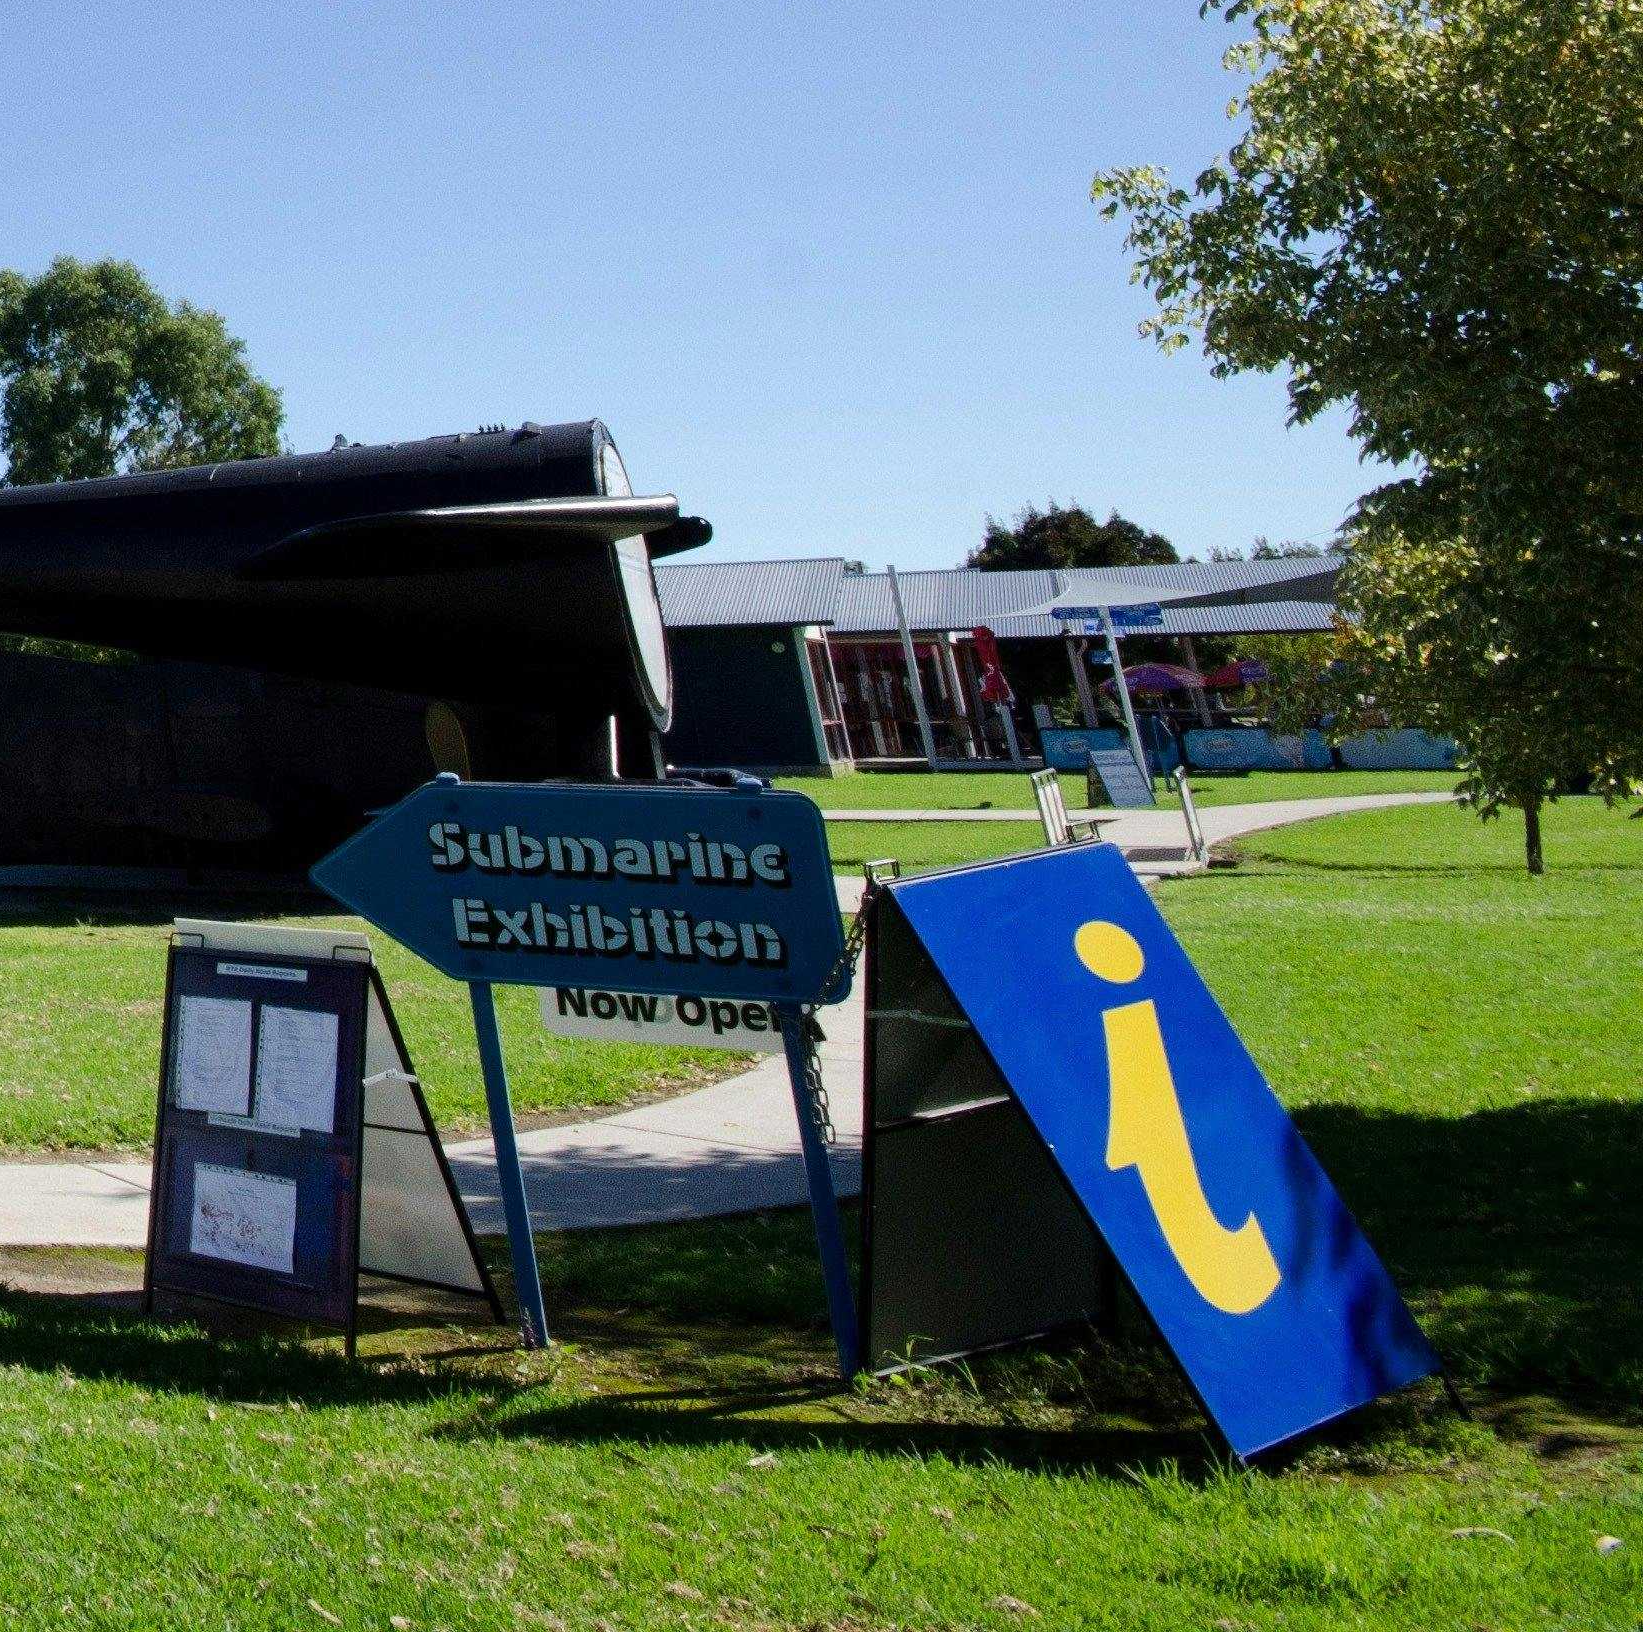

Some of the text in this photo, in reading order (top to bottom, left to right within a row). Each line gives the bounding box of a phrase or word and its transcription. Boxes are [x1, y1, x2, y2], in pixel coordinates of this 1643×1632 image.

[427, 822, 791, 886] Submarine
[452, 897, 786, 965] Exhibition
[556, 986, 658, 1023] Now
